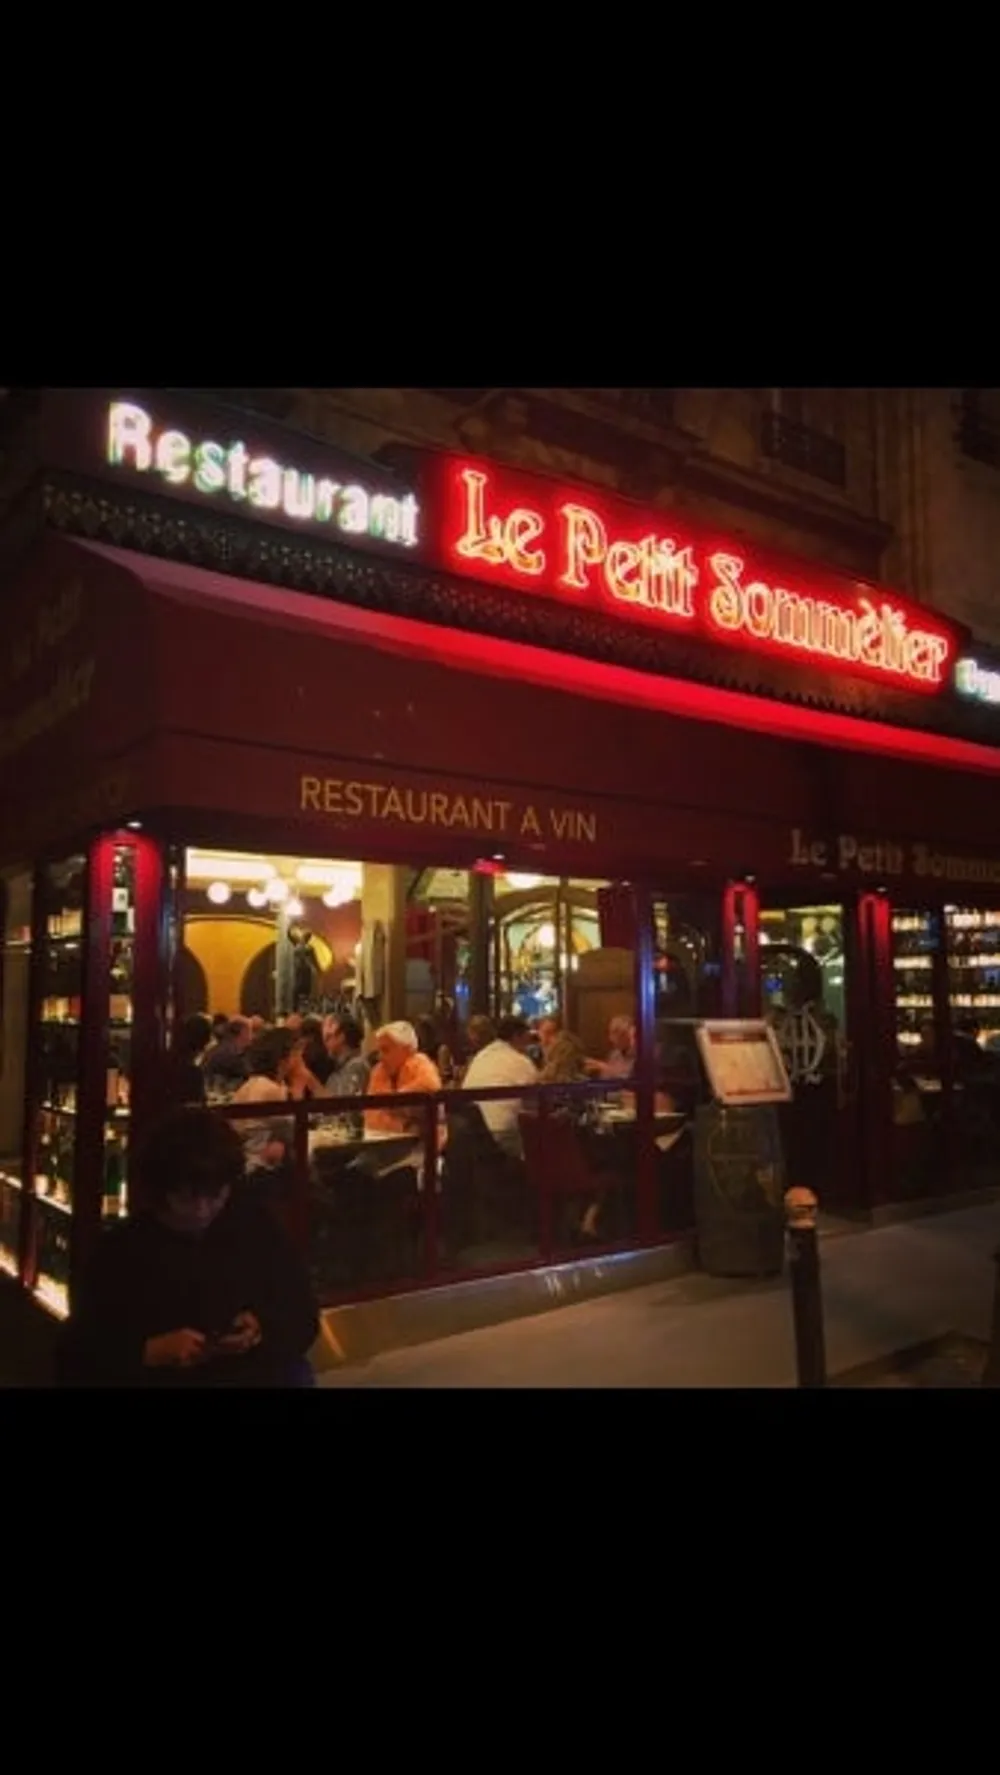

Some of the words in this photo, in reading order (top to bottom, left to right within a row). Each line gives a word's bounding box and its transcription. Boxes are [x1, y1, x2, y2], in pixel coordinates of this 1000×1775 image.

[107, 400, 420, 547] Restaurant
[456, 468, 546, 576] Le
[559, 502, 701, 617] Petit
[300, 776, 511, 831] RESTAURANT
[520, 805, 542, 836] A
[550, 808, 597, 842] VIN
[789, 828, 828, 867] Le
[838, 834, 905, 875] Petit
